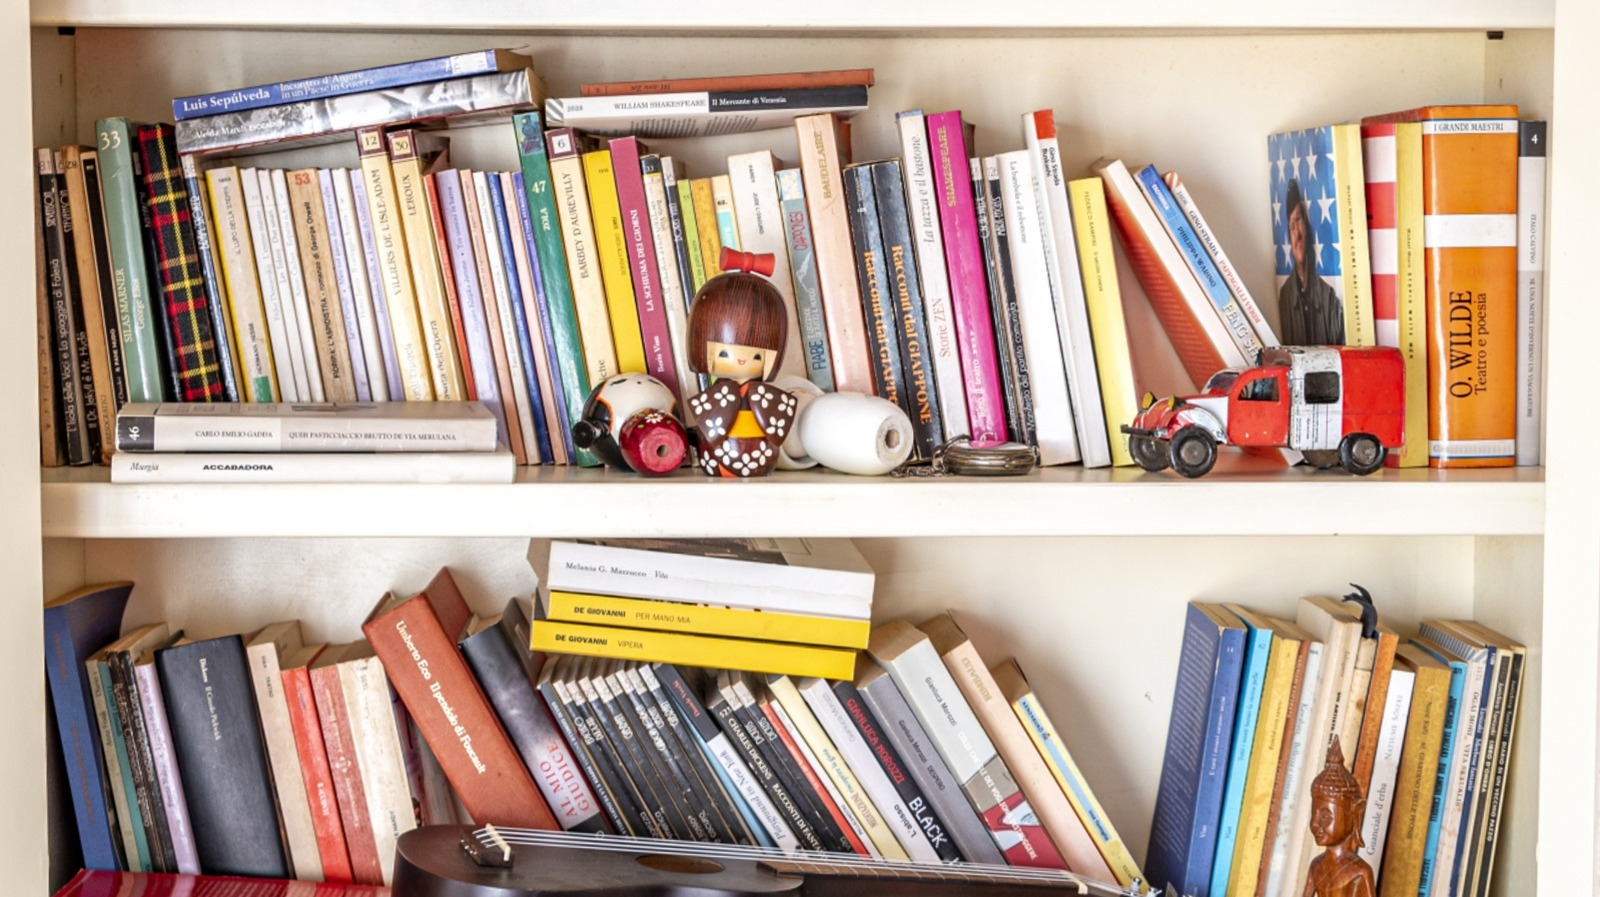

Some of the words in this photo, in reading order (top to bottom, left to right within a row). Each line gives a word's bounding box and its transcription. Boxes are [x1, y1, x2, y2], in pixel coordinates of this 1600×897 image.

[280, 78, 320, 91] Incontro
[304, 84, 328, 95] Paese
[340, 78, 374, 90] Guerra
[184, 98, 208, 112] Luis
[210, 88, 270, 109] Sepúlveda
[614, 102, 648, 110] WILLIAM
[650, 99, 706, 109] SHAKESPEARE
[720, 98, 750, 106] Mercante
[752, 96, 760, 105] di
[760, 96, 786, 104] Venezia
[101, 130, 122, 150] 33
[1438, 123, 1469, 132] GRANDI
[1470, 122, 1504, 131] MAESTRI
[1530, 134, 1538, 144] 4
[365, 136, 378, 148] 12
[558, 139, 566, 149] 6
[813, 130, 832, 199] BAUDELAIRE
[912, 136, 924, 176] bastone
[937, 124, 956, 206] SHAKESPEARE
[1048, 146, 1056, 163] Gino
[1052, 164, 1060, 186] Strada
[294, 172, 310, 186] 53
[532, 180, 546, 194] 47
[402, 174, 416, 216] LEROUX
[562, 172, 582, 236] D'AUREVILLY
[44, 190, 56, 228] STEVENSON
[304, 202, 314, 224] Orwell
[540, 208, 550, 230] ZOLA
[920, 198, 932, 228] tazza
[308, 226, 318, 250] George
[630, 209, 642, 242] GIORNI
[923, 230, 934, 242] La
[382, 233, 394, 248] DE
[636, 243, 644, 259] DEI
[312, 252, 320, 260] di
[574, 238, 589, 278] BARBEY
[1177, 226, 1198, 258] PHILIPPA
[1197, 258, 1217, 288] WARING
[1189, 210, 1203, 228] GINO
[1201, 228, 1219, 258] STRADA
[1218, 260, 1246, 300] PAPPAGALLI
[50, 258, 62, 288] Falesà
[386, 250, 402, 296] VILLIERS
[638, 260, 652, 299] SCHIUMA
[892, 245, 912, 311] Racconti
[52, 288, 62, 298] di
[116, 268, 128, 312] MARNER
[864, 252, 884, 316] Racconti
[875, 320, 890, 344] dal
[55, 300, 68, 338] spiaggia
[134, 300, 146, 330] George
[646, 300, 654, 312] LA
[931, 298, 946, 322] ZEN
[1474, 292, 1489, 335] poesia
[122, 314, 132, 342] SILAS
[320, 298, 334, 346] L'ASPIDISTRA
[902, 314, 918, 338] dal
[1008, 302, 1022, 343] comunista
[1450, 290, 1472, 370] WILDE
[428, 320, 446, 371] dell'Opera
[937, 325, 950, 358] Storie
[656, 354, 664, 372] Boris
[808, 340, 826, 370] FIABE
[1016, 345, 1026, 372] partito
[61, 360, 70, 380] Voci
[908, 340, 932, 425] GIAPPONE
[1020, 374, 1029, 388] del
[1474, 350, 1488, 395] Teatro
[63, 382, 74, 402] delle
[85, 384, 96, 406] Jekyll
[1450, 376, 1472, 398] O.
[1023, 390, 1035, 431] Manifesto
[129, 426, 140, 440] 46
[418, 433, 456, 441] MERULANA
[130, 462, 159, 472] Murgia
[566, 562, 596, 572] Melania
[611, 567, 647, 577] Mazzucco
[586, 607, 626, 618] GIOVANNI
[636, 612, 650, 620] PER
[652, 614, 674, 622] MANO
[676, 616, 690, 624] MIA
[396, 620, 422, 660] Umberto
[568, 636, 608, 646] GIOVANNI
[618, 640, 644, 649] VIPERA
[416, 659, 432, 680] Eco
[959, 656, 992, 701] RIMBAUD
[199, 658, 210, 682] Dickens
[210, 714, 222, 740] Pickwick
[430, 681, 442, 694] Il
[431, 691, 461, 726] pendolo
[1470, 691, 1480, 713] OGAI
[1295, 702, 1310, 735] Kawabata
[1330, 703, 1340, 730] ARTISTA
[1466, 714, 1476, 736] MORI
[454, 724, 467, 736] di
[458, 734, 487, 774] Foucault
[717, 749, 735, 769] York
[898, 720, 915, 742] Gianluca
[913, 742, 927, 764] Morozzi
[927, 765, 946, 792] DESPERO
[924, 676, 942, 702] Gianluca
[941, 702, 957, 726] Morozzi
[982, 774, 994, 788] DEI
[989, 786, 1014, 819] VOGLIONO
[1289, 742, 1301, 768] Bellezza
[1462, 744, 1472, 764] VITA
[1485, 739, 1496, 760] LIBRO
[1498, 740, 1508, 764] DIARIO
[540, 760, 564, 794] MIO
[547, 740, 590, 812] GIUDICE
[728, 718, 752, 750] CHARLES
[749, 749, 772, 780] DICKENS
[772, 782, 798, 820] RACCONTI
[797, 820, 804, 828] DI
[730, 767, 748, 787] New
[846, 698, 878, 746] GIANLUCA
[876, 744, 905, 784] MOROZZI
[908, 796, 948, 848] BLACK
[1412, 752, 1425, 788] GIARDINO
[1480, 761, 1493, 793] D'OMBRA
[1494, 775, 1503, 786] UN
[742, 785, 755, 798] in
[1410, 790, 1420, 812] DELLE
[1490, 788, 1502, 818] VECCHIO
[561, 796, 578, 818] AL
[749, 794, 786, 841] Playground
[891, 803, 917, 837] L'abisso
[1365, 812, 1383, 856] Guanciale
[1374, 782, 1387, 810] d'erba
[1093, 819, 1109, 841] famiglia
[1199, 824, 1208, 838] Vian
[1224, 826, 1233, 839] Vian
[1406, 814, 1418, 840] PEONIE
[1486, 819, 1496, 842] PAZZO
